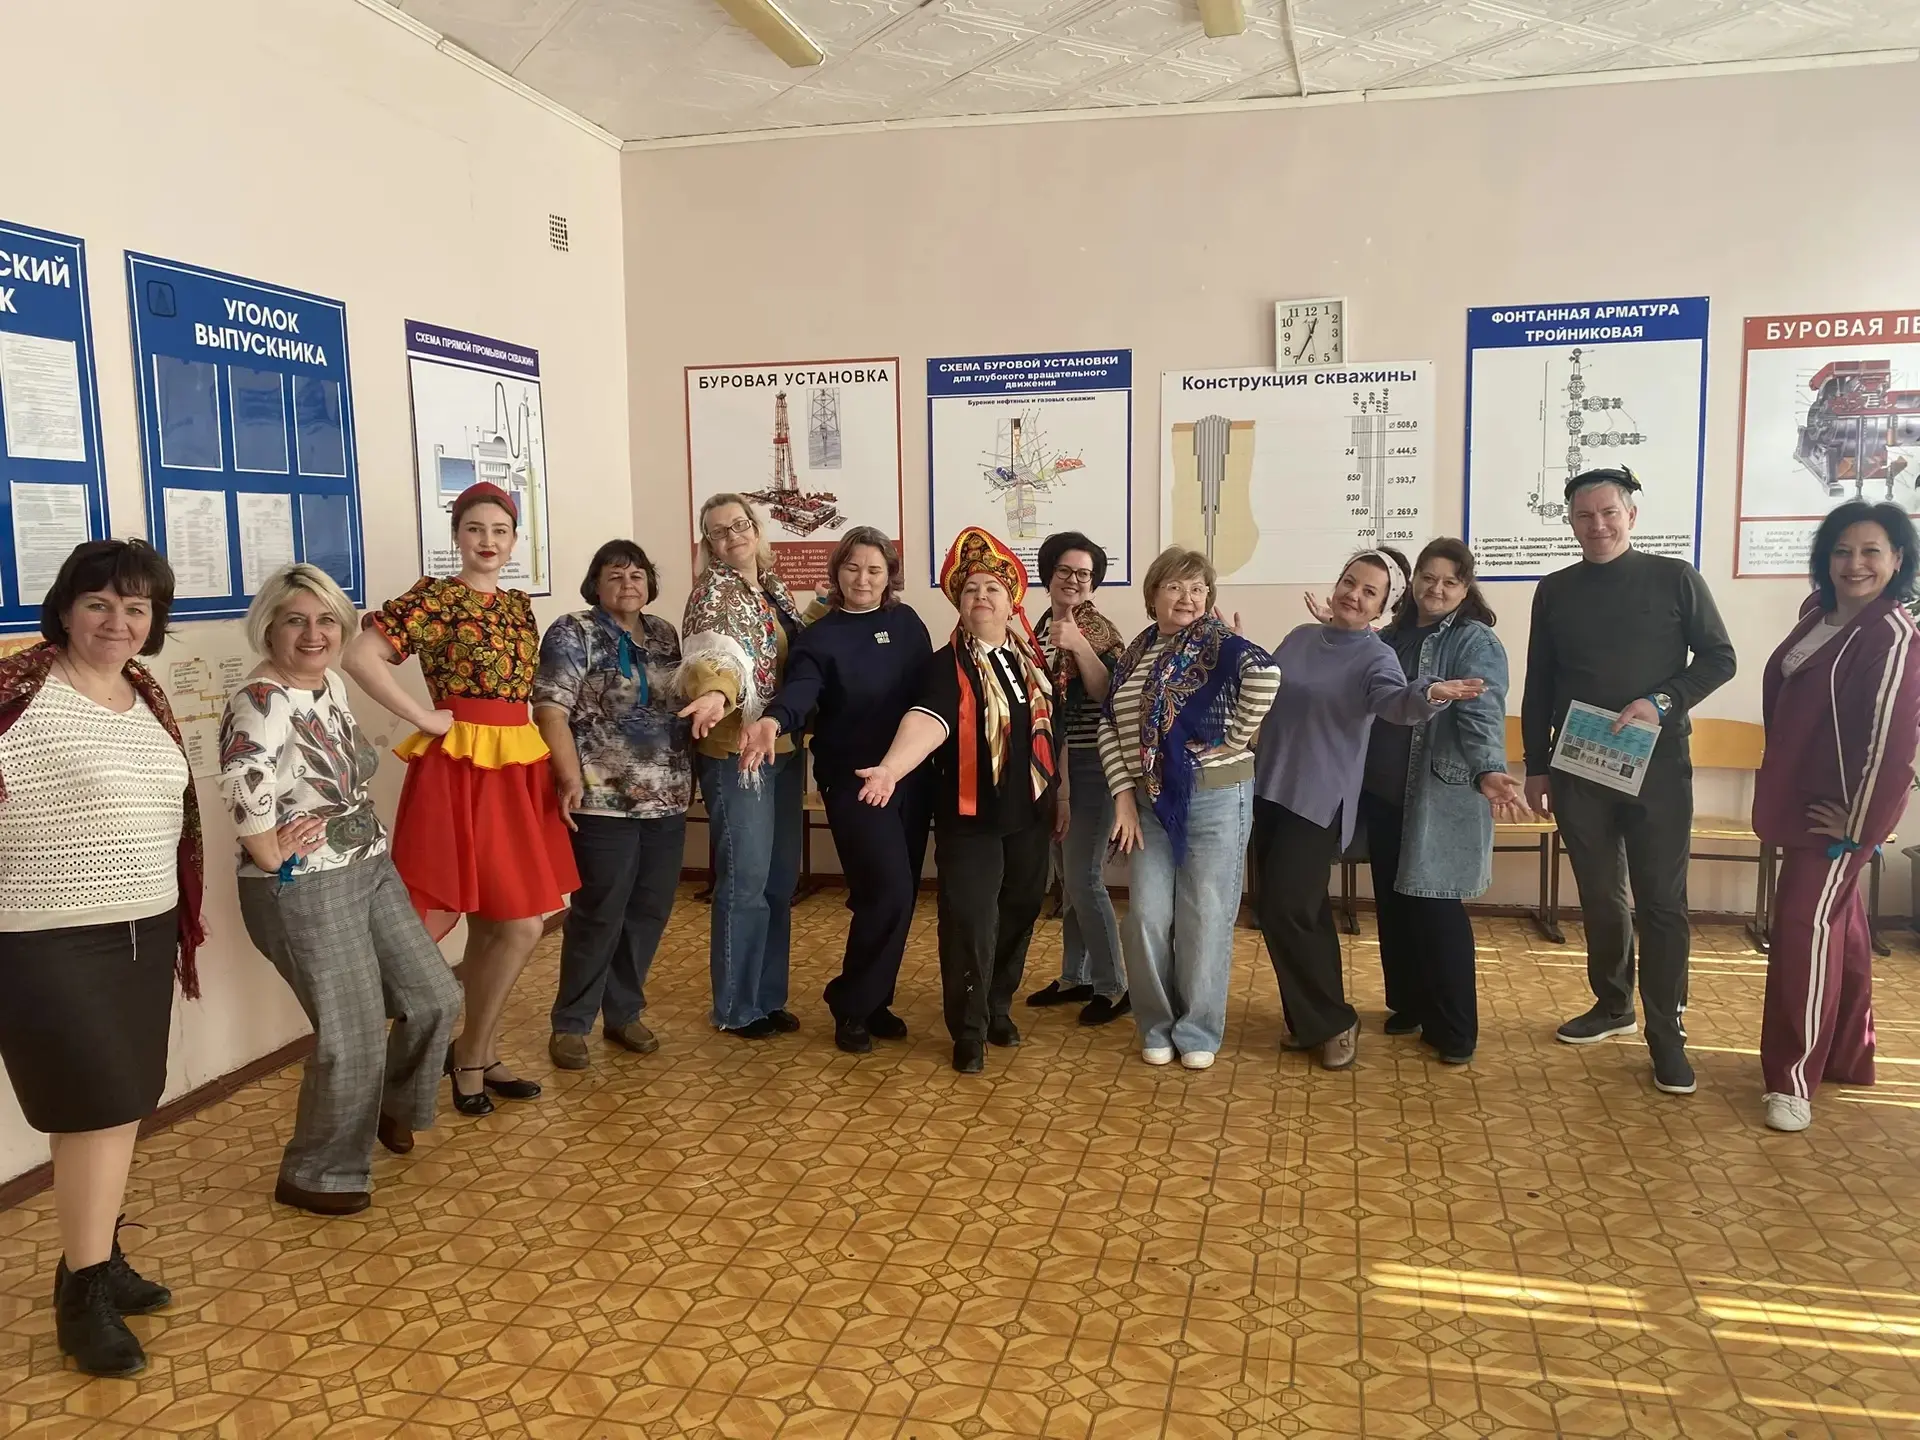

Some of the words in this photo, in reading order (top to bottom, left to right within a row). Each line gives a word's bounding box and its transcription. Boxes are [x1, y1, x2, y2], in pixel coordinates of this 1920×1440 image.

[223, 297, 300, 334] УГОЛОК
[1289, 308, 1299, 318] 11
[1305, 306, 1317, 317] 12
[1324, 305, 1329, 315] 1
[1491, 308, 1590, 324] ФОНТАННАЯ
[1595, 303, 1680, 319] АРМАТУРА
[1282, 317, 1293, 328] 10
[1331, 313, 1338, 324] 2
[1331, 328, 1339, 338] 3
[1525, 325, 1643, 342] ТРОЙНИКОВАЯ
[1766, 317, 1883, 340] БУРОВАЯ
[1284, 332, 1291, 342] 9
[194, 322, 328, 367] ВЫПУСКНИКА
[415, 332, 441, 347] СХЕМА
[442, 337, 472, 353] ПРЯМОЙ
[472, 344, 507, 361] ПРОМЫВКИ
[508, 352, 534, 367] СКВАЖИН
[1331, 342, 1338, 352] 4
[1284, 346, 1291, 356] 8
[1293, 355, 1299, 365] 7
[1308, 354, 1315, 363] 6
[1323, 352, 1330, 362] 5
[939, 362, 980, 373] СХЕМА
[984, 358, 1041, 370] БУРОВОЙ
[1044, 356, 1118, 368] УСТАНОВКИ
[699, 373, 778, 389] БУРОВАЯ
[785, 369, 889, 386] УСТАНОВКА
[953, 375, 971, 384] для
[974, 372, 1025, 383] глубокого
[1028, 369, 1107, 380] вращательного
[1182, 373, 1307, 391] Конструкция
[1314, 370, 1417, 386] скважины
[1005, 380, 1057, 389] движения
